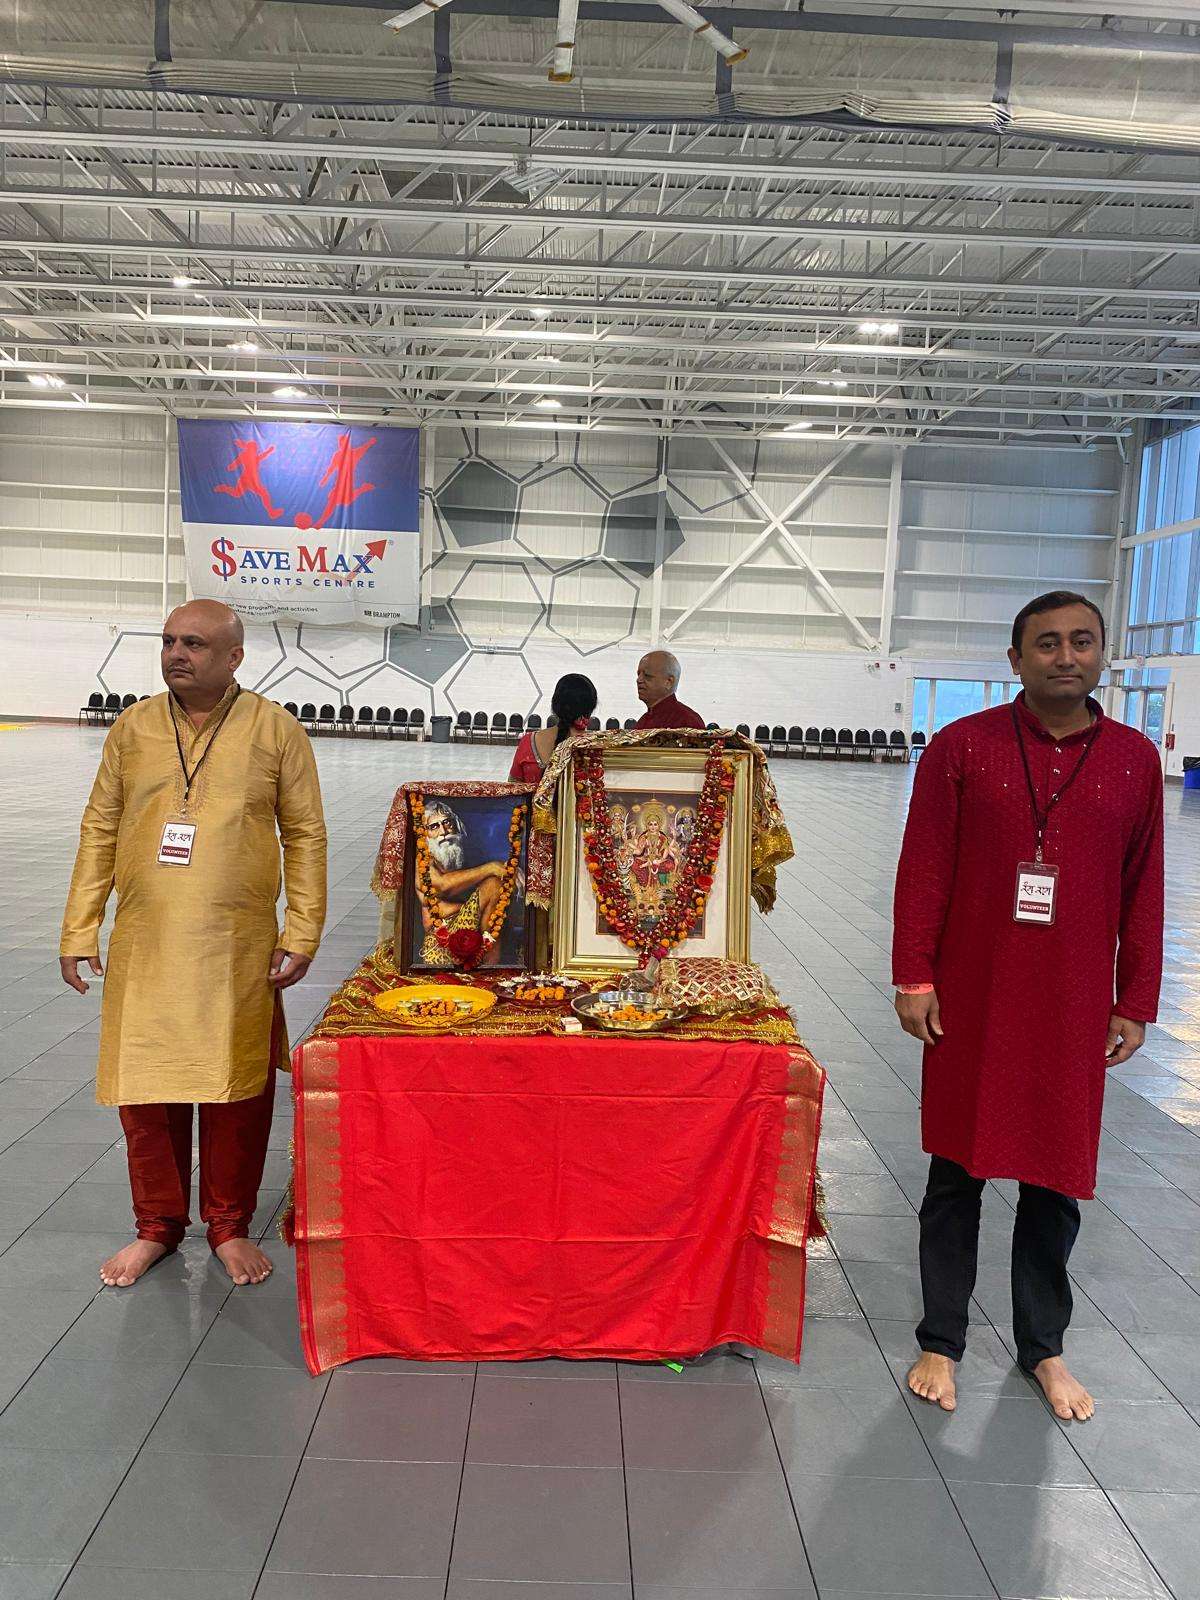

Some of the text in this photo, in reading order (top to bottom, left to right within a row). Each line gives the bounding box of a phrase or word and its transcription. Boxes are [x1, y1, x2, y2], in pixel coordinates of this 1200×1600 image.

[240, 575, 376, 588] SPORTS CENTRE
[372, 611, 401, 619] BRAMPTON
[1020, 903, 1049, 911] VOLUNTEER
